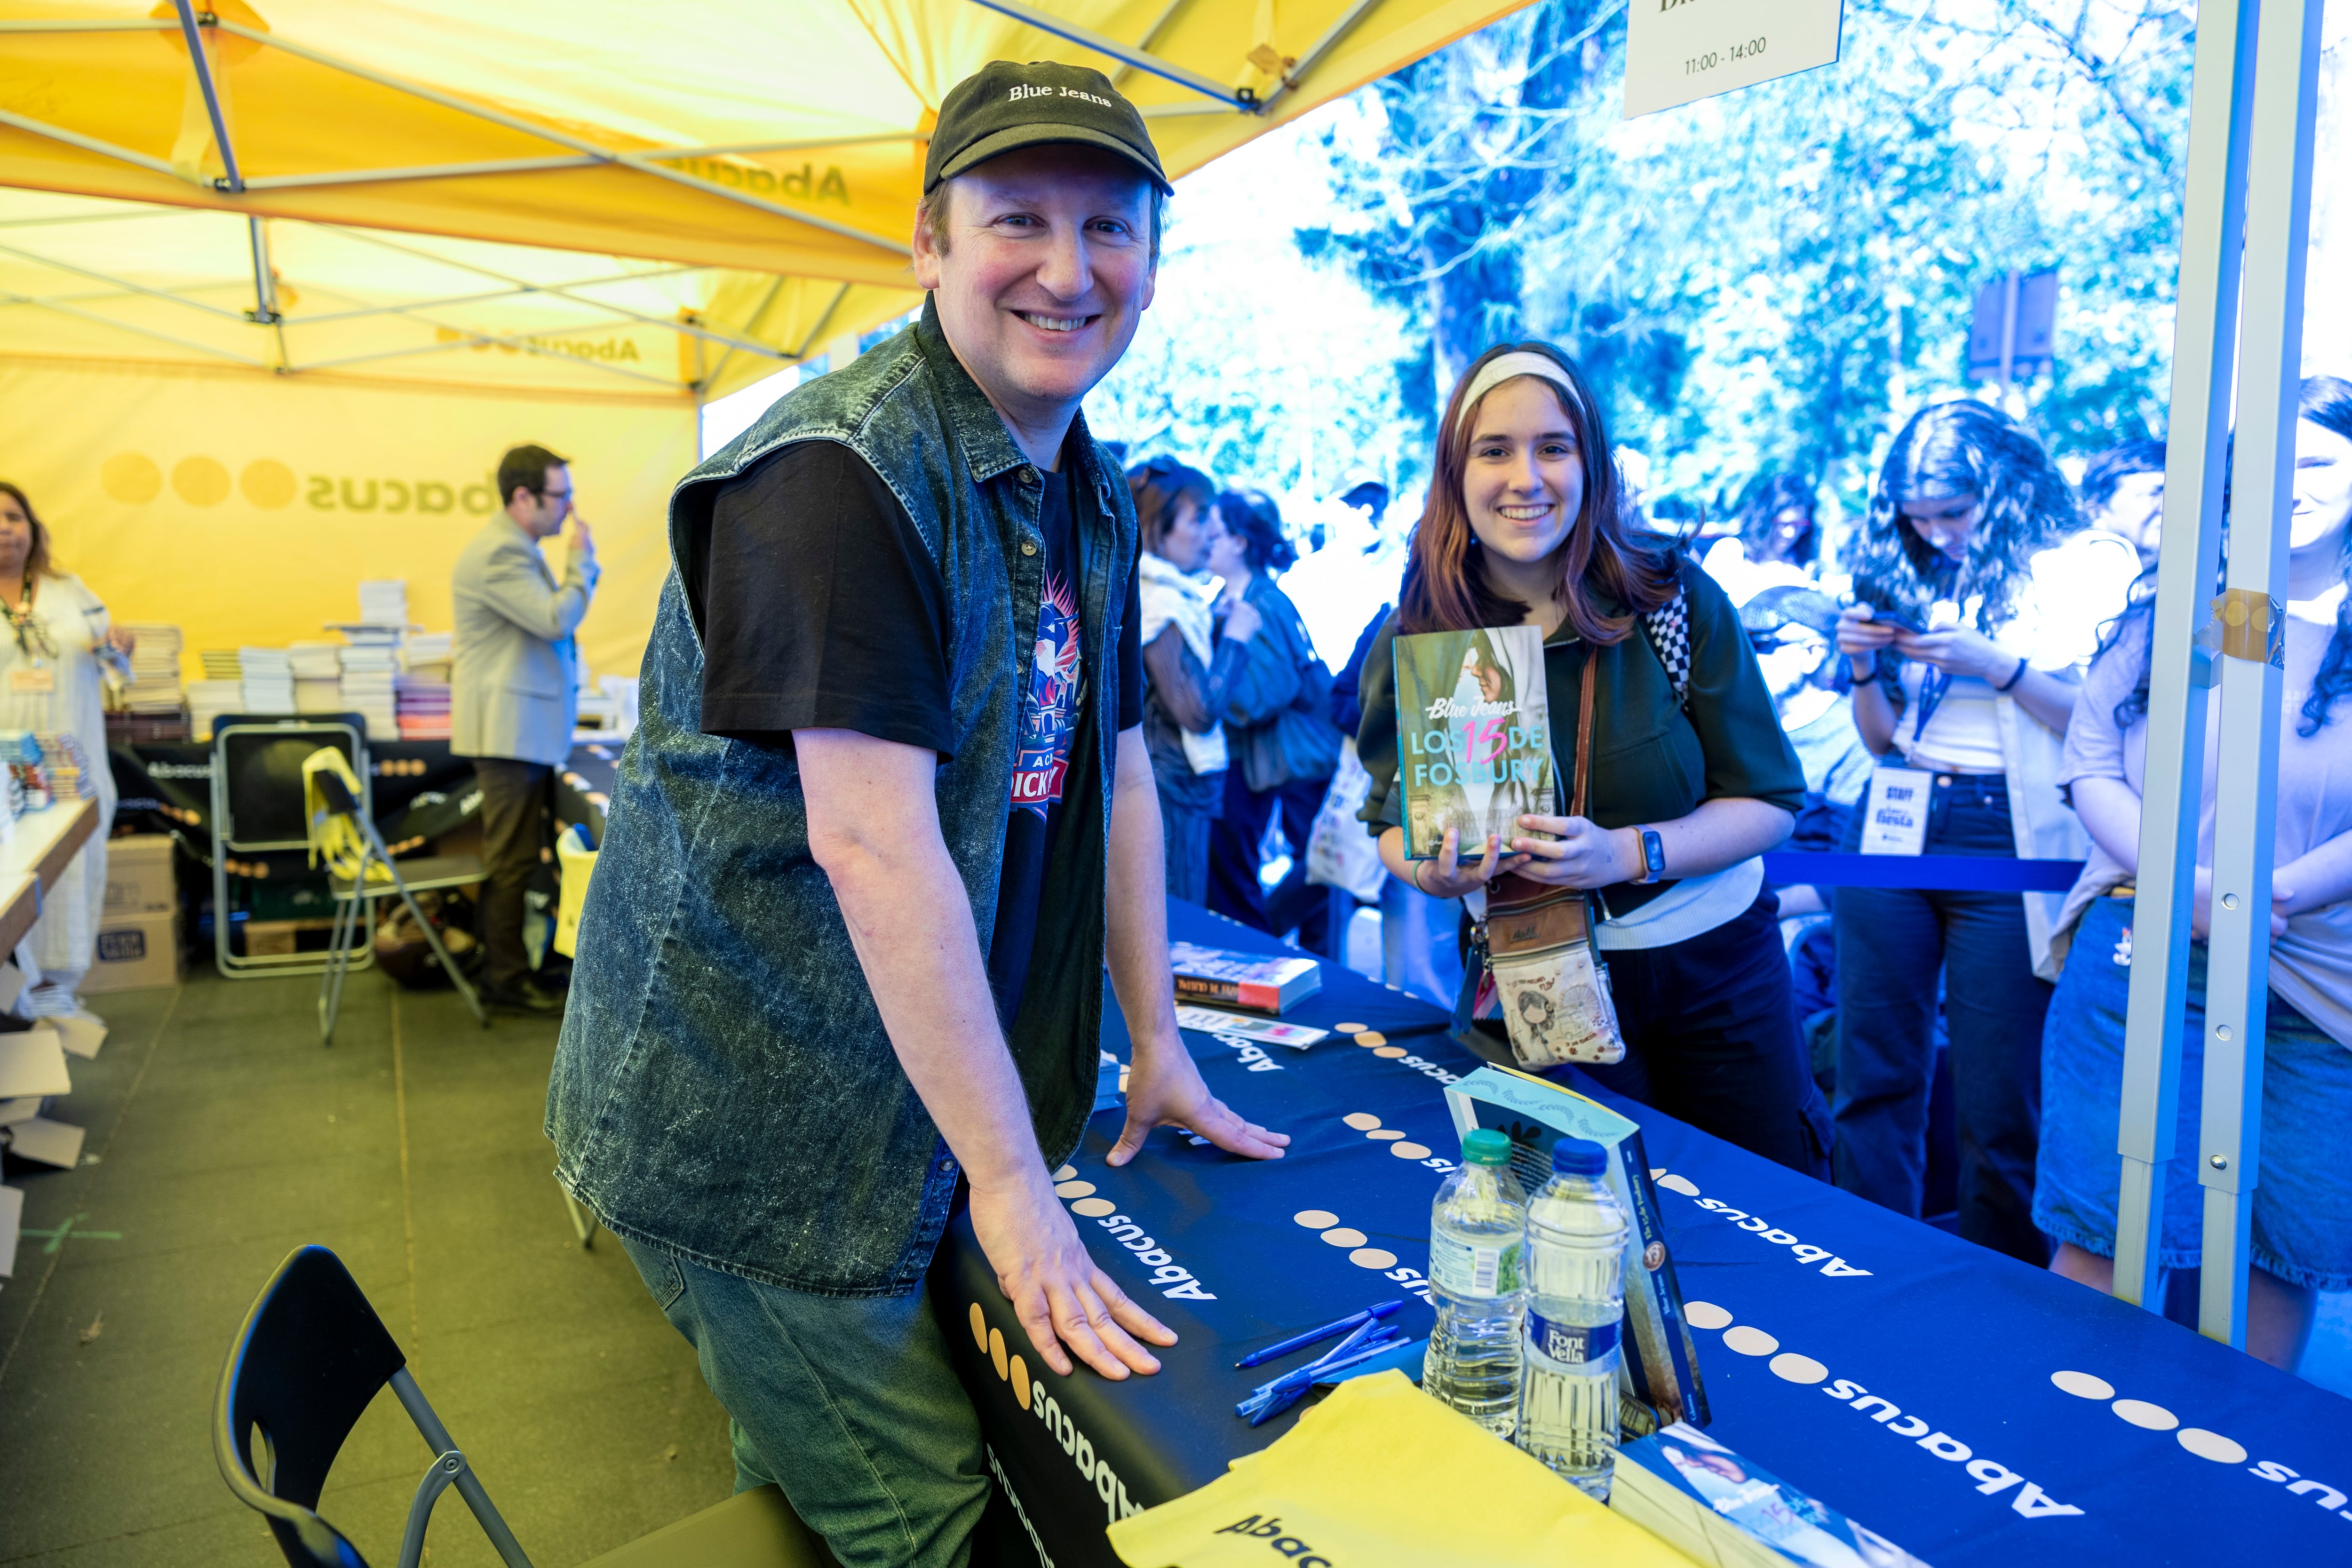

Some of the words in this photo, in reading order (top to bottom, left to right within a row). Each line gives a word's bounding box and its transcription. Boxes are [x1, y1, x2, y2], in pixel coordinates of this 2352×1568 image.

[1685, 52, 1717, 75] 11:00
[1730, 37, 1766, 62] 14:00
[1009, 84, 1052, 102] Blue
[1059, 87, 1112, 107] Jeans
[1425, 697, 1469, 719] Blue
[1470, 696, 1523, 717] Jeans
[1411, 730, 1464, 755] LOS
[1462, 717, 1508, 765] 15
[1508, 726, 1543, 749] DE
[1414, 758, 1543, 787] FOSBURY
[1693, 1198, 1874, 1277] Abacus
[1097, 1215, 1217, 1299] Abacus
[1548, 1343, 1584, 1363] Vella
[1549, 1329, 1585, 1350] Font
[1822, 1379, 2085, 1519] Abacus
